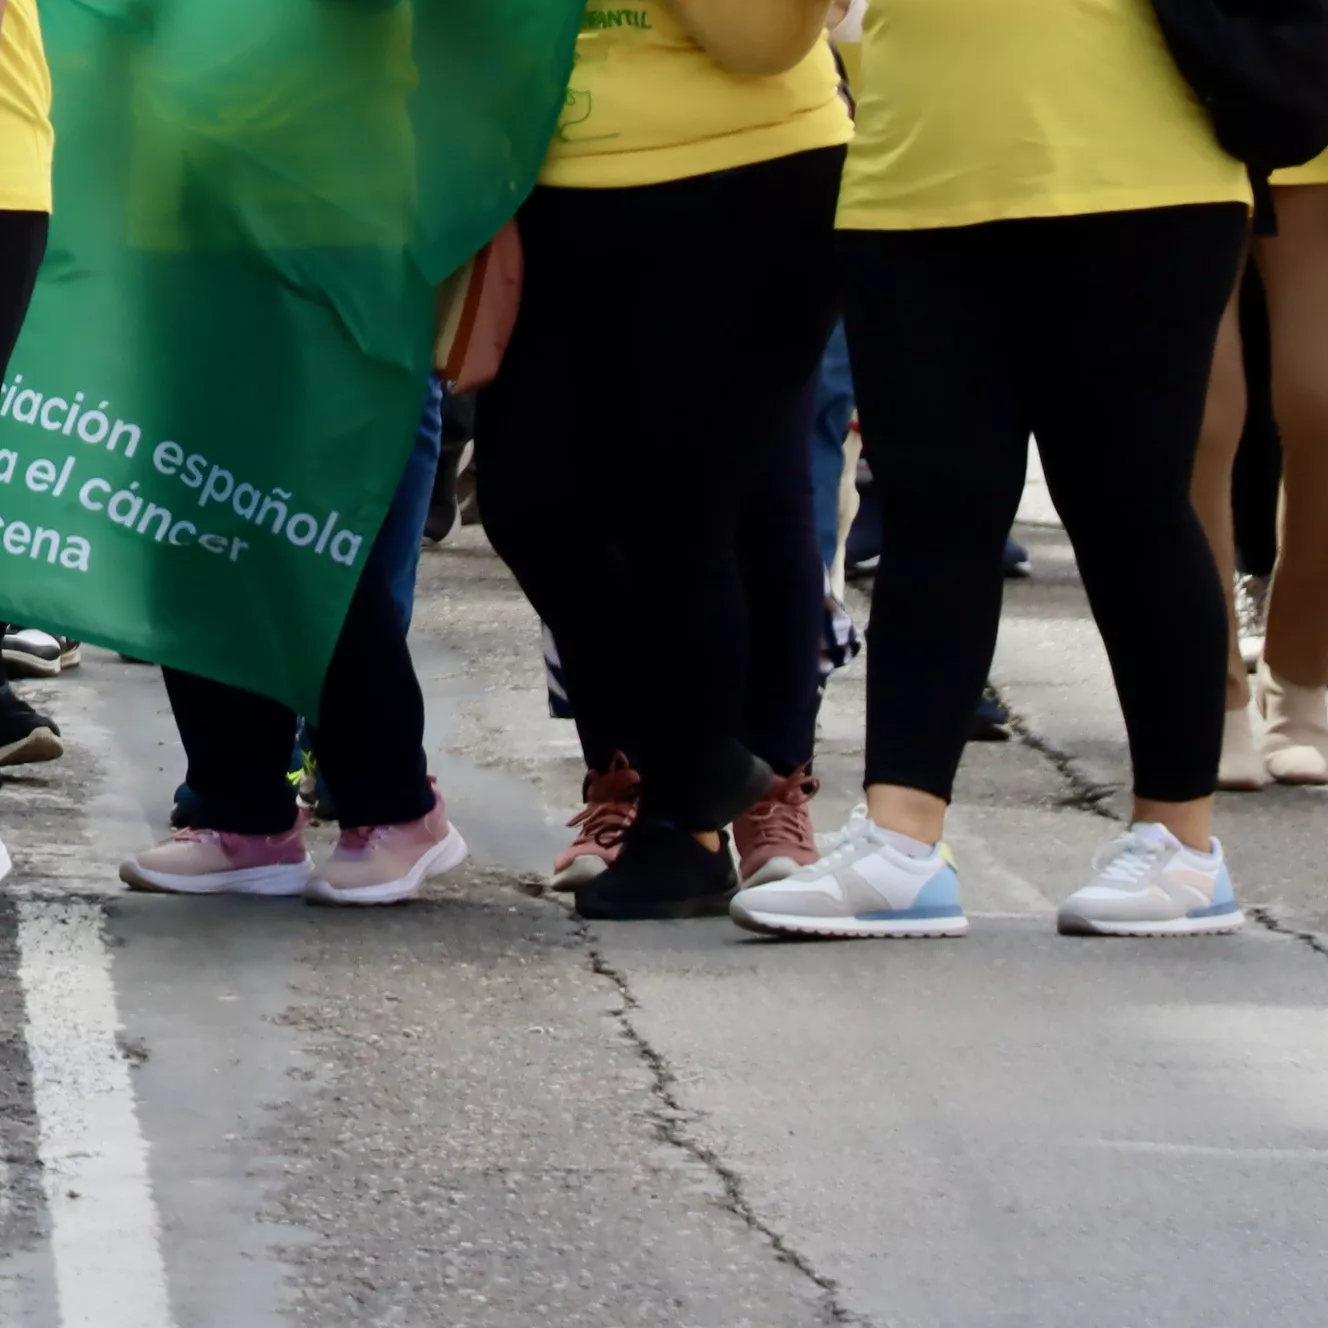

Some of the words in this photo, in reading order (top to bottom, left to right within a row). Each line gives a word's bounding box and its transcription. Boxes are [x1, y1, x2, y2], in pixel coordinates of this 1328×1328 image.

[0, 373, 143, 458] iación
[152, 439, 364, 567] española
[25, 456, 76, 497] el
[79, 478, 249, 562] cáncer
